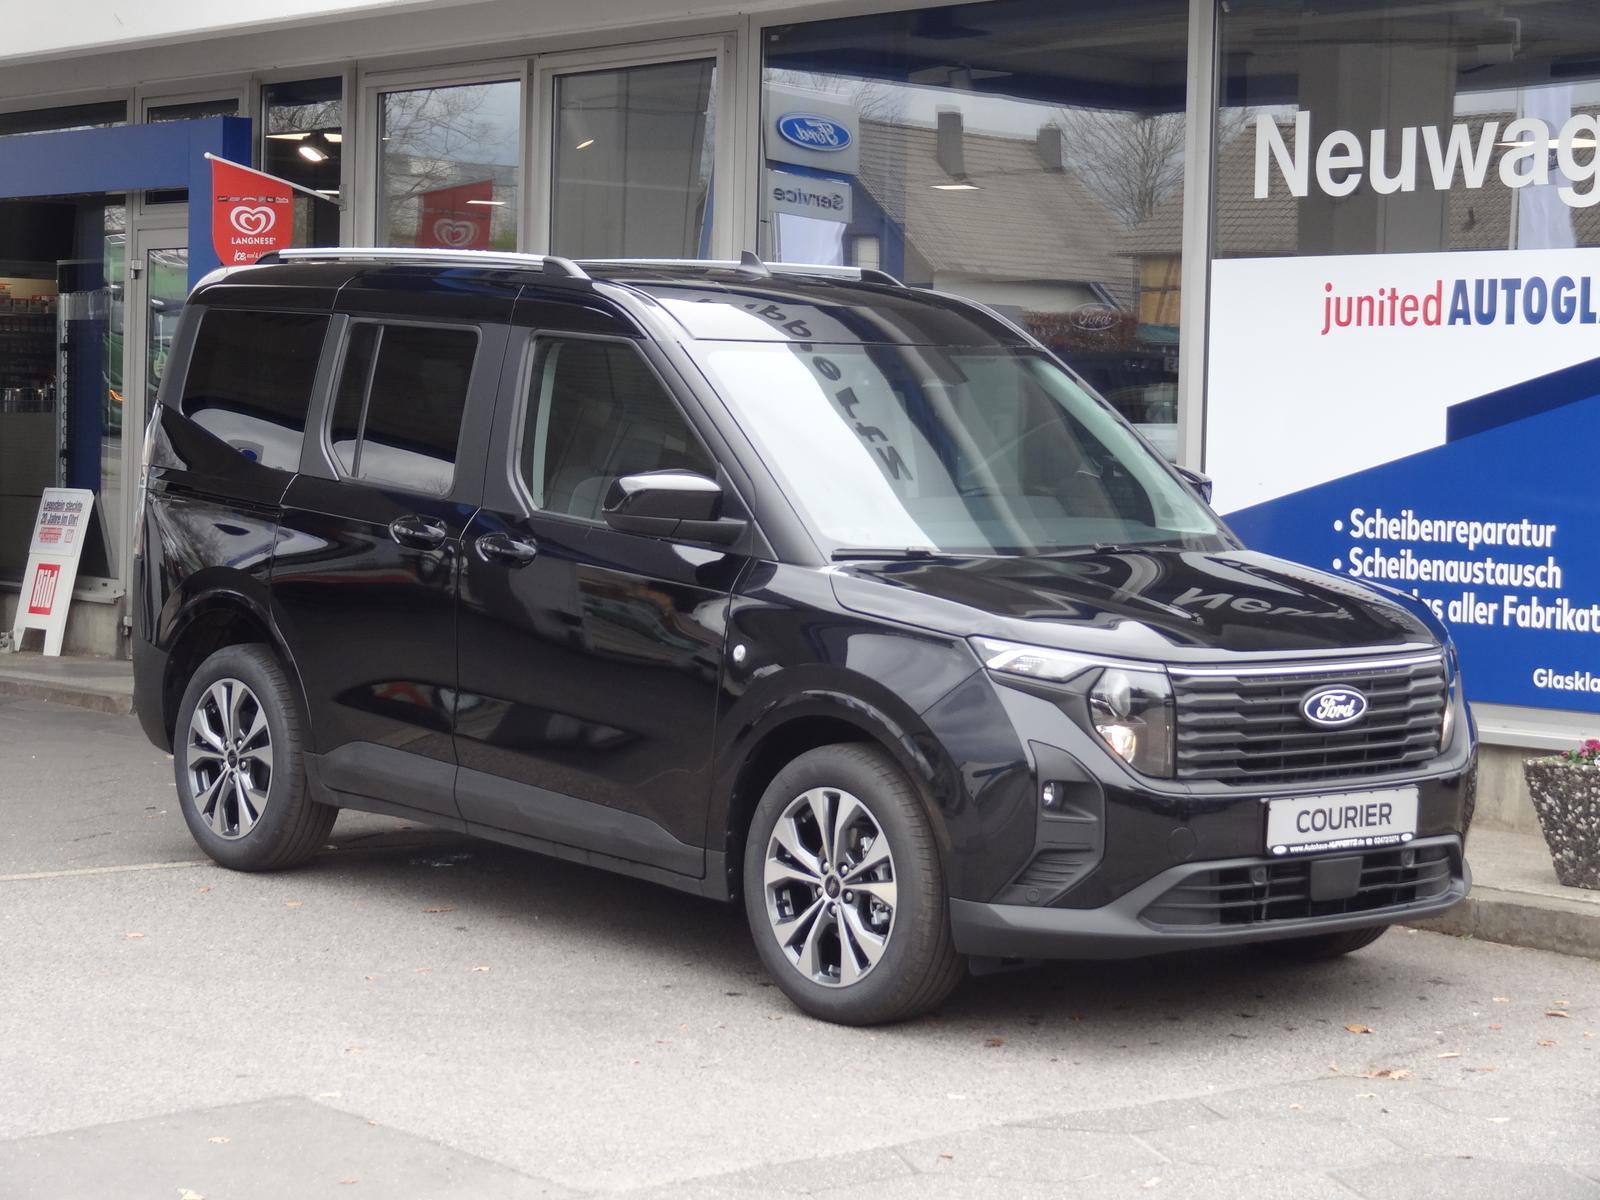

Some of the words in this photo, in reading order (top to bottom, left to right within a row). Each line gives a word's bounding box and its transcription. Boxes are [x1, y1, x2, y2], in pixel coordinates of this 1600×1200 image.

[1254, 110, 1600, 208] Neuwag
[231, 236, 274, 245] LANGNESE
[1321, 280, 1443, 336] junited
[1447, 275, 1600, 326] AUTOGL
[1350, 508, 1556, 550] Scheibenreparatur
[1348, 547, 1561, 588] Scheibenaustausch
[31, 568, 59, 609] Bild
[1448, 591, 1498, 625] aller
[1315, 693, 1357, 720] Ford
[1296, 802, 1393, 834] COURIER
